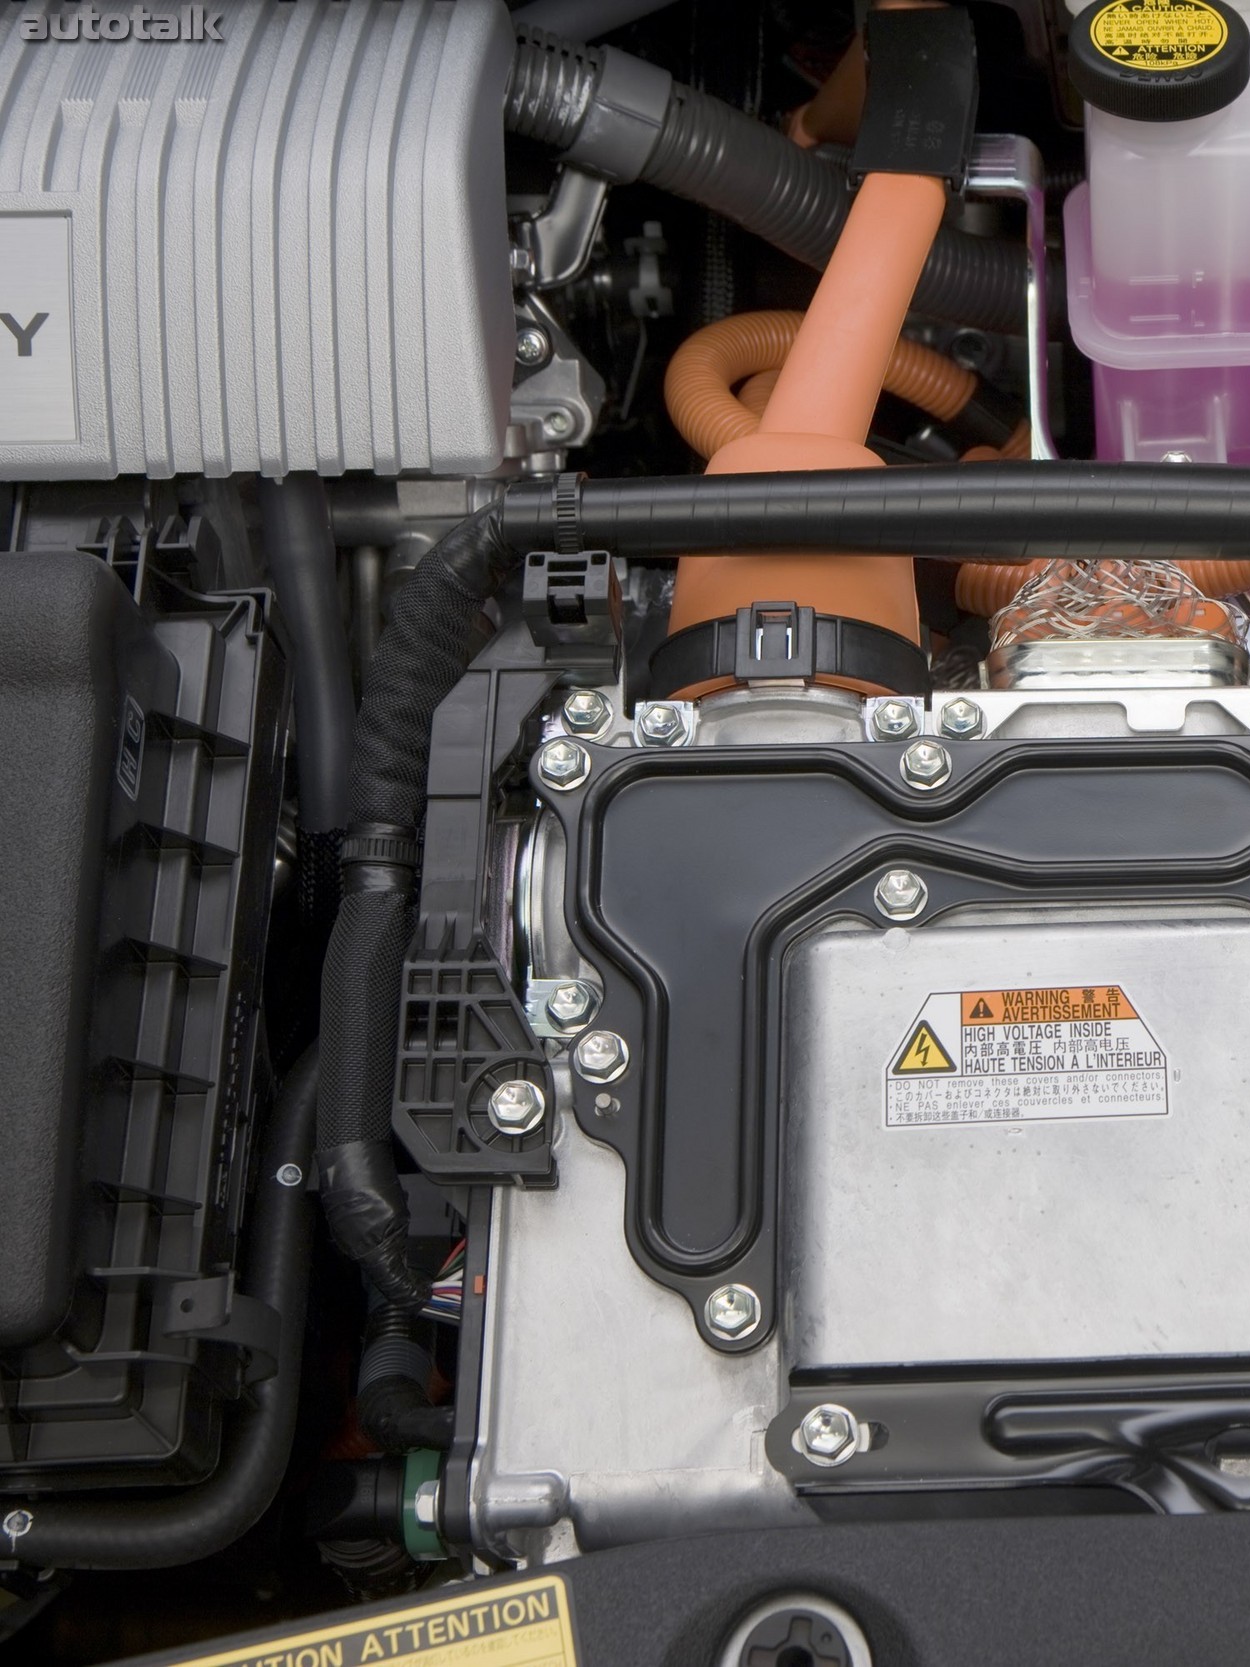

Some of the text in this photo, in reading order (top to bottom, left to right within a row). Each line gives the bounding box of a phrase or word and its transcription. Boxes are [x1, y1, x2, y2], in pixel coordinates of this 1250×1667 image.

[0, 313, 49, 357] Y
[1002, 990, 1070, 1006] WARNING
[1002, 1003, 1121, 1022] AVERTISSEMENT
[964, 1022, 1112, 1042] HIGH VOLTAGE INSIDE
[965, 1056, 1006, 1074] HAUTE
[1010, 1054, 1065, 1072] TENSION
[895, 1071, 1164, 1090] DO NOT remove these covers and/or connectors.
[895, 1092, 1164, 1112] NE PAS enlever ces couvercles et connecteurs.
[360, 1591, 550, 1662] ATTENTION
